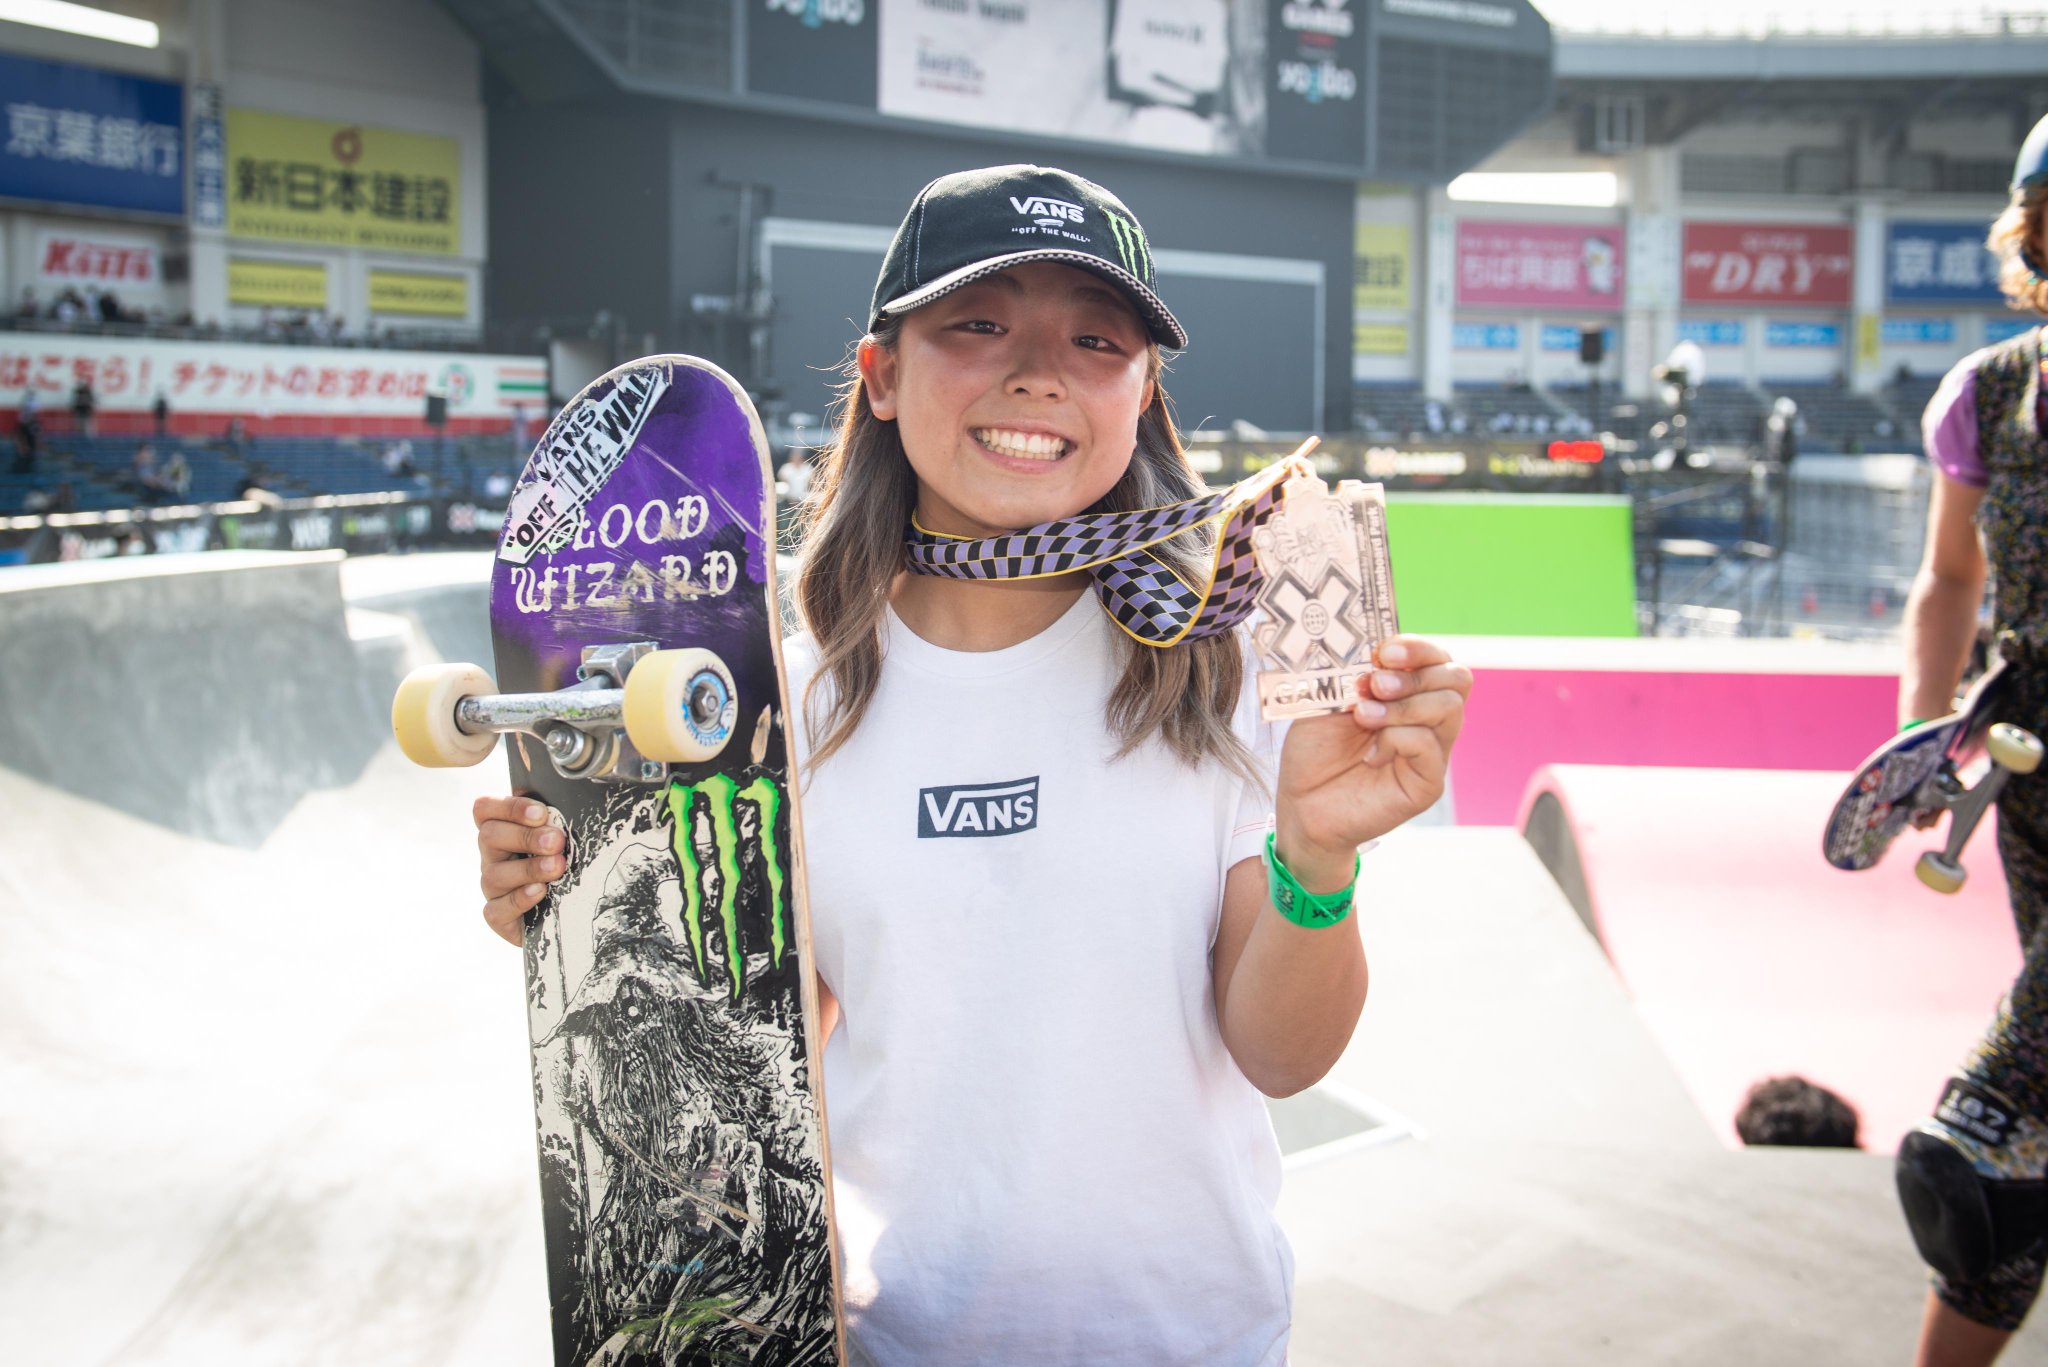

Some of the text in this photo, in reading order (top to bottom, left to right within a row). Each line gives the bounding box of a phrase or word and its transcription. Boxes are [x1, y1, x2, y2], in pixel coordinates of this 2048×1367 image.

[6, 101, 179, 177] 京葉銀行
[235, 156, 451, 224] 新日本建設
[1010, 196, 1085, 224] VANS
[1011, 226, 1091, 243] "OFF THE WALL"
[551, 431, 611, 498] THE
[540, 494, 710, 554] LOOD
[1367, 505, 1382, 536] Park
[510, 549, 738, 614] WIZARD
[1371, 537, 1390, 609] Skateboard
[1274, 674, 1357, 705] GAME
[923, 781, 1037, 832] VANS
